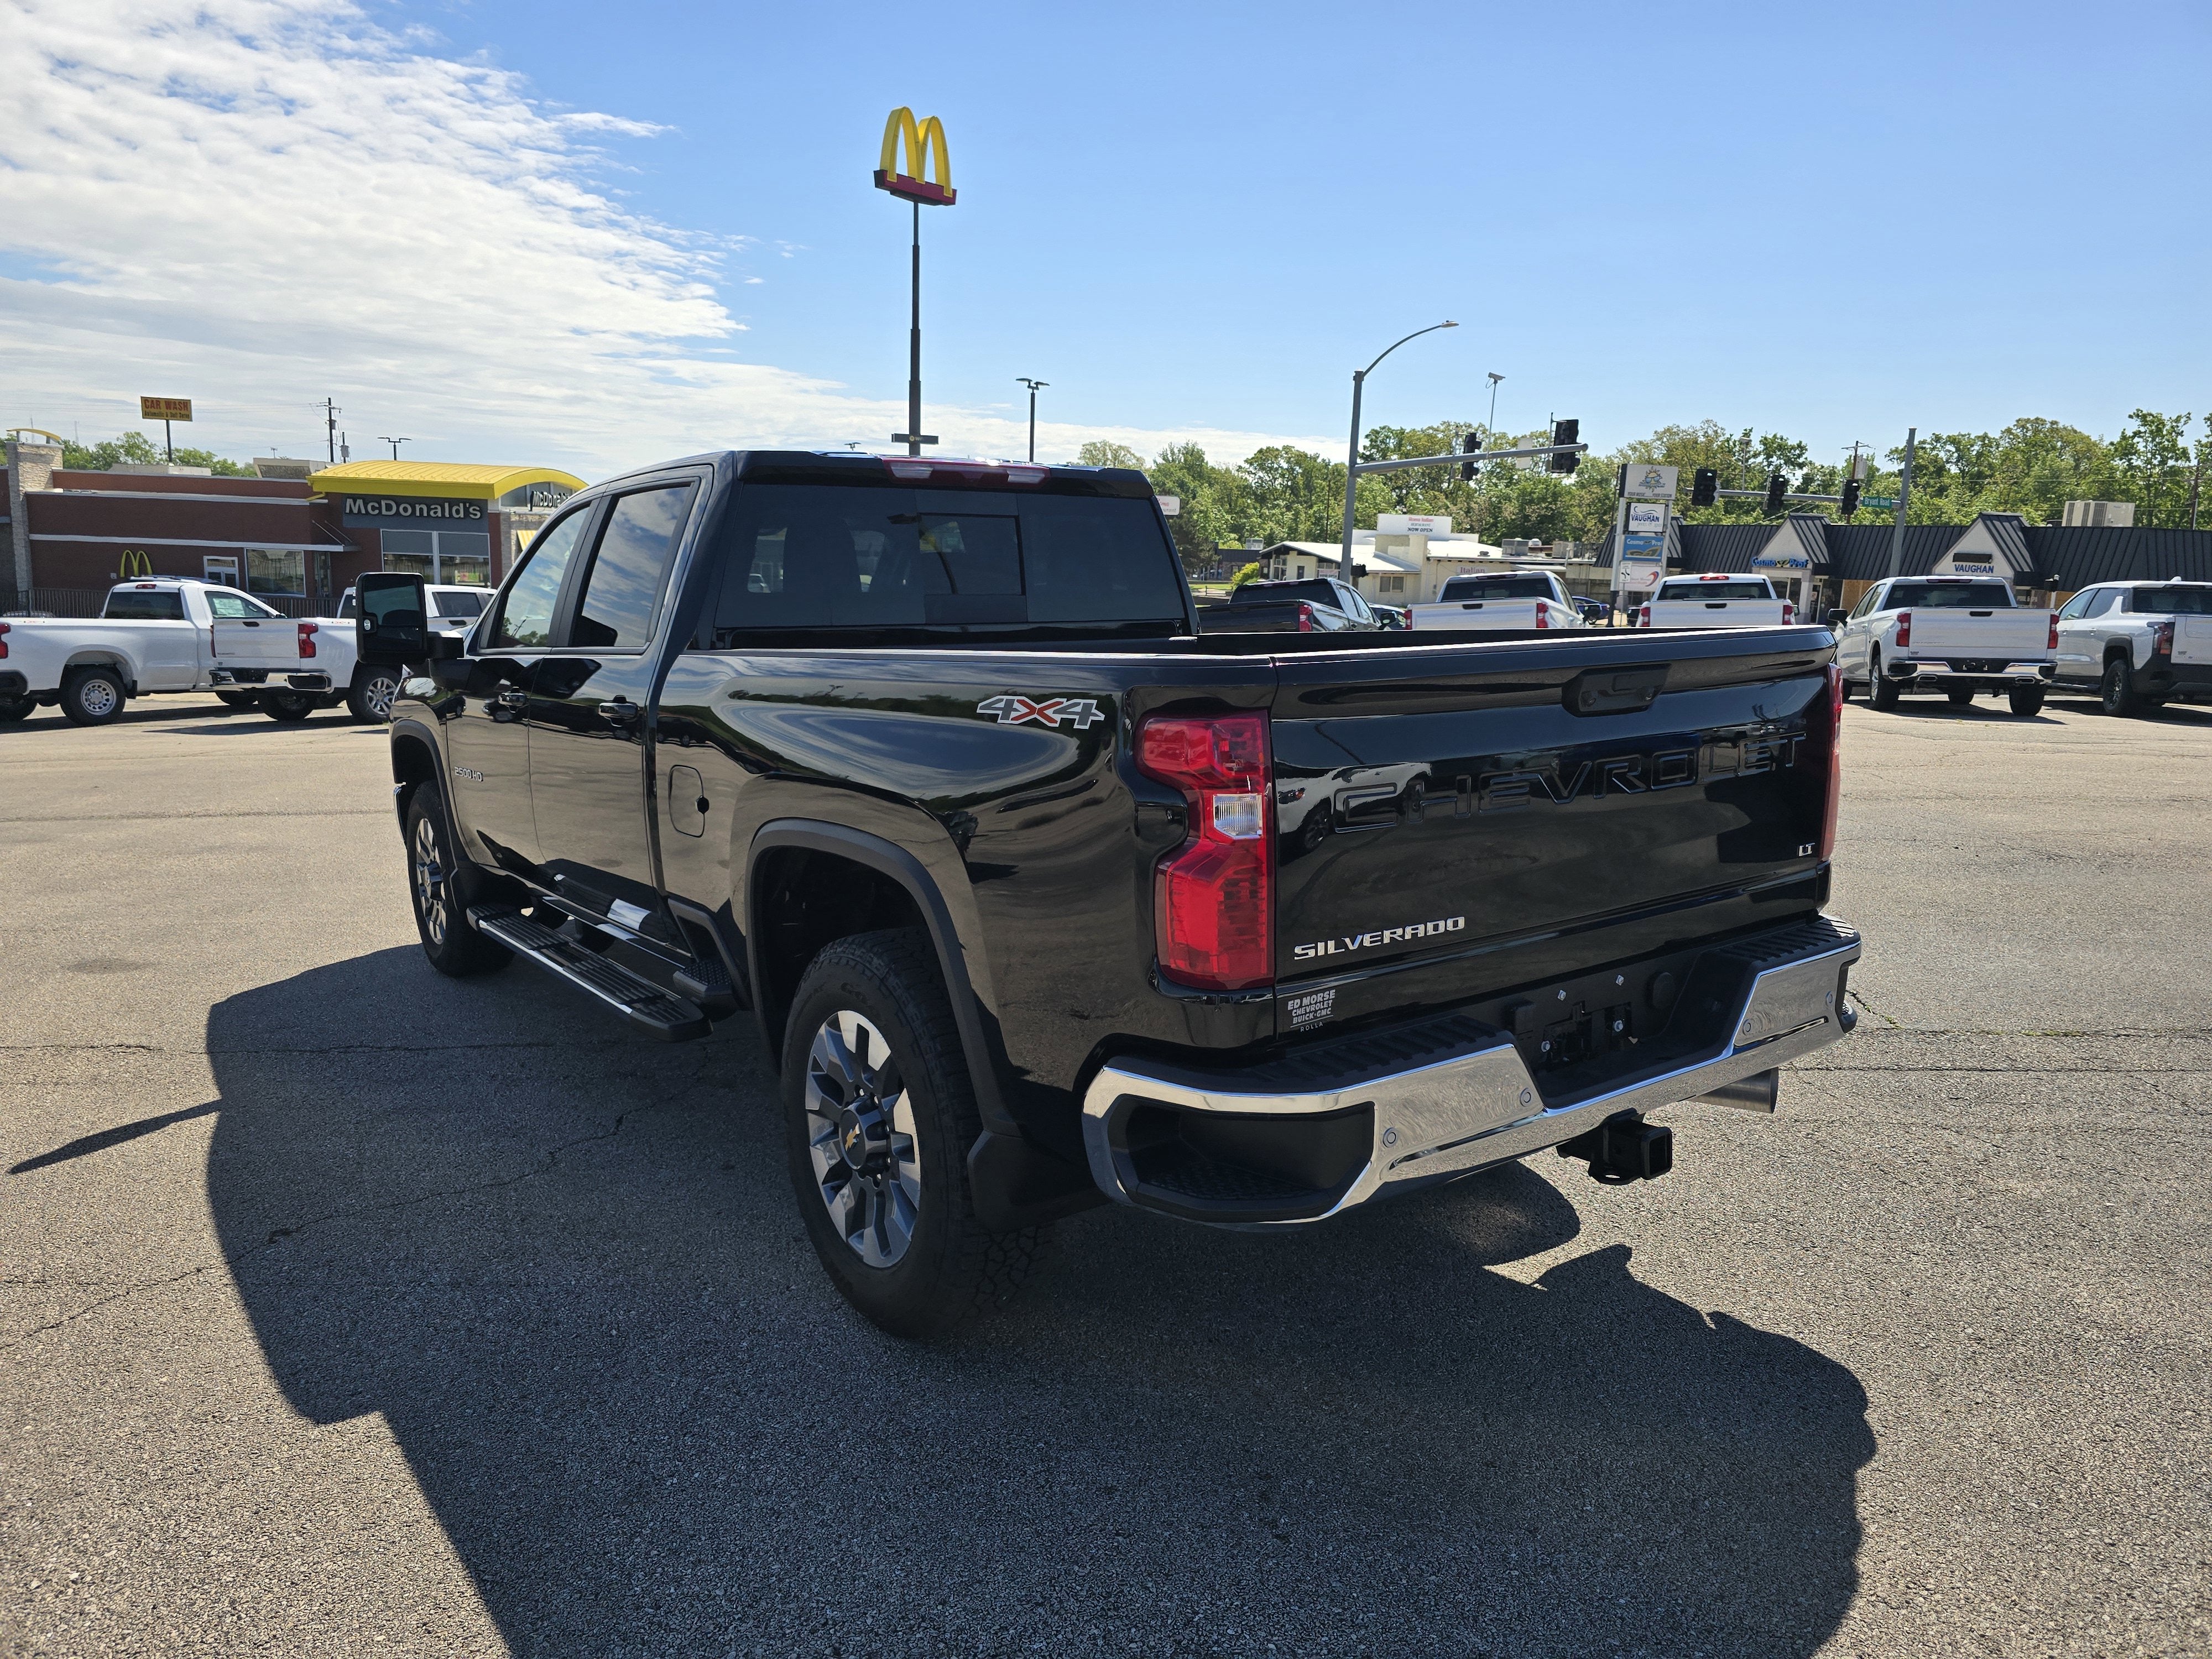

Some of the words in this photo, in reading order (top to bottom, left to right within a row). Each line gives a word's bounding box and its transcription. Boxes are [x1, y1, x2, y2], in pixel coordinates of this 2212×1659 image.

[144, 399, 161, 410] CAR
[164, 400, 189, 411] WASH
[1865, 497, 1878, 506] Bryant
[345, 498, 481, 519] McDonald's
[1752, 557, 1776, 567] Cosmo
[1789, 558, 1808, 567] Prof
[1954, 564, 1994, 573] VAUGHAN
[1334, 732, 1807, 832] CHEVROLET
[1797, 843, 1815, 856] LT
[1294, 916, 1465, 960] SILVERADO
[1287, 999, 1301, 1010] ED
[1302, 989, 1335, 1006] MORSE
[1292, 999, 1333, 1016] CHEVROLET
[1300, 1021, 1323, 1032] ROLLA
